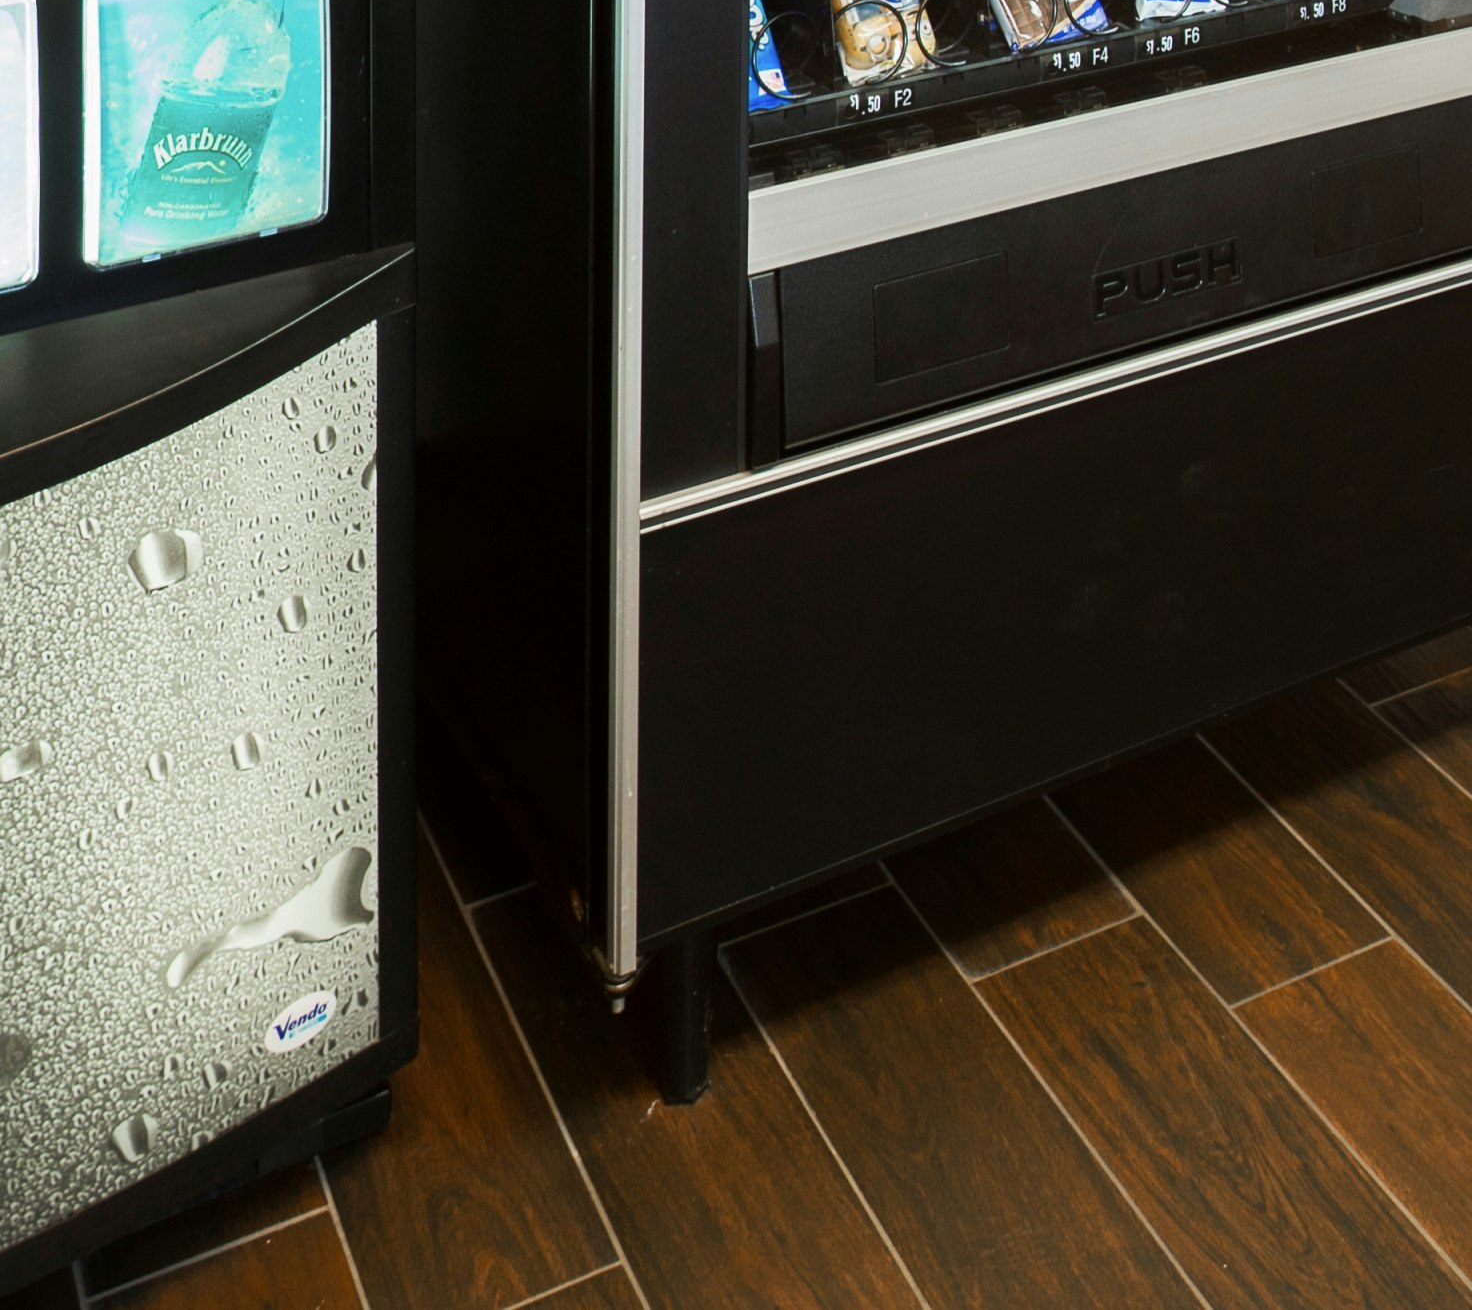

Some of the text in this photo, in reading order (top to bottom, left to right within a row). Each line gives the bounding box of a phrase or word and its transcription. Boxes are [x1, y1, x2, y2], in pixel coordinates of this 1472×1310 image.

[1184, 28, 1200, 45] F6
[1092, 46, 1109, 65] F4
[894, 88, 912, 108] F2
[153, 126, 253, 170] Klarbrunn
[1093, 241, 1242, 320] PUSH
[273, 1002, 327, 1041] Vendo
